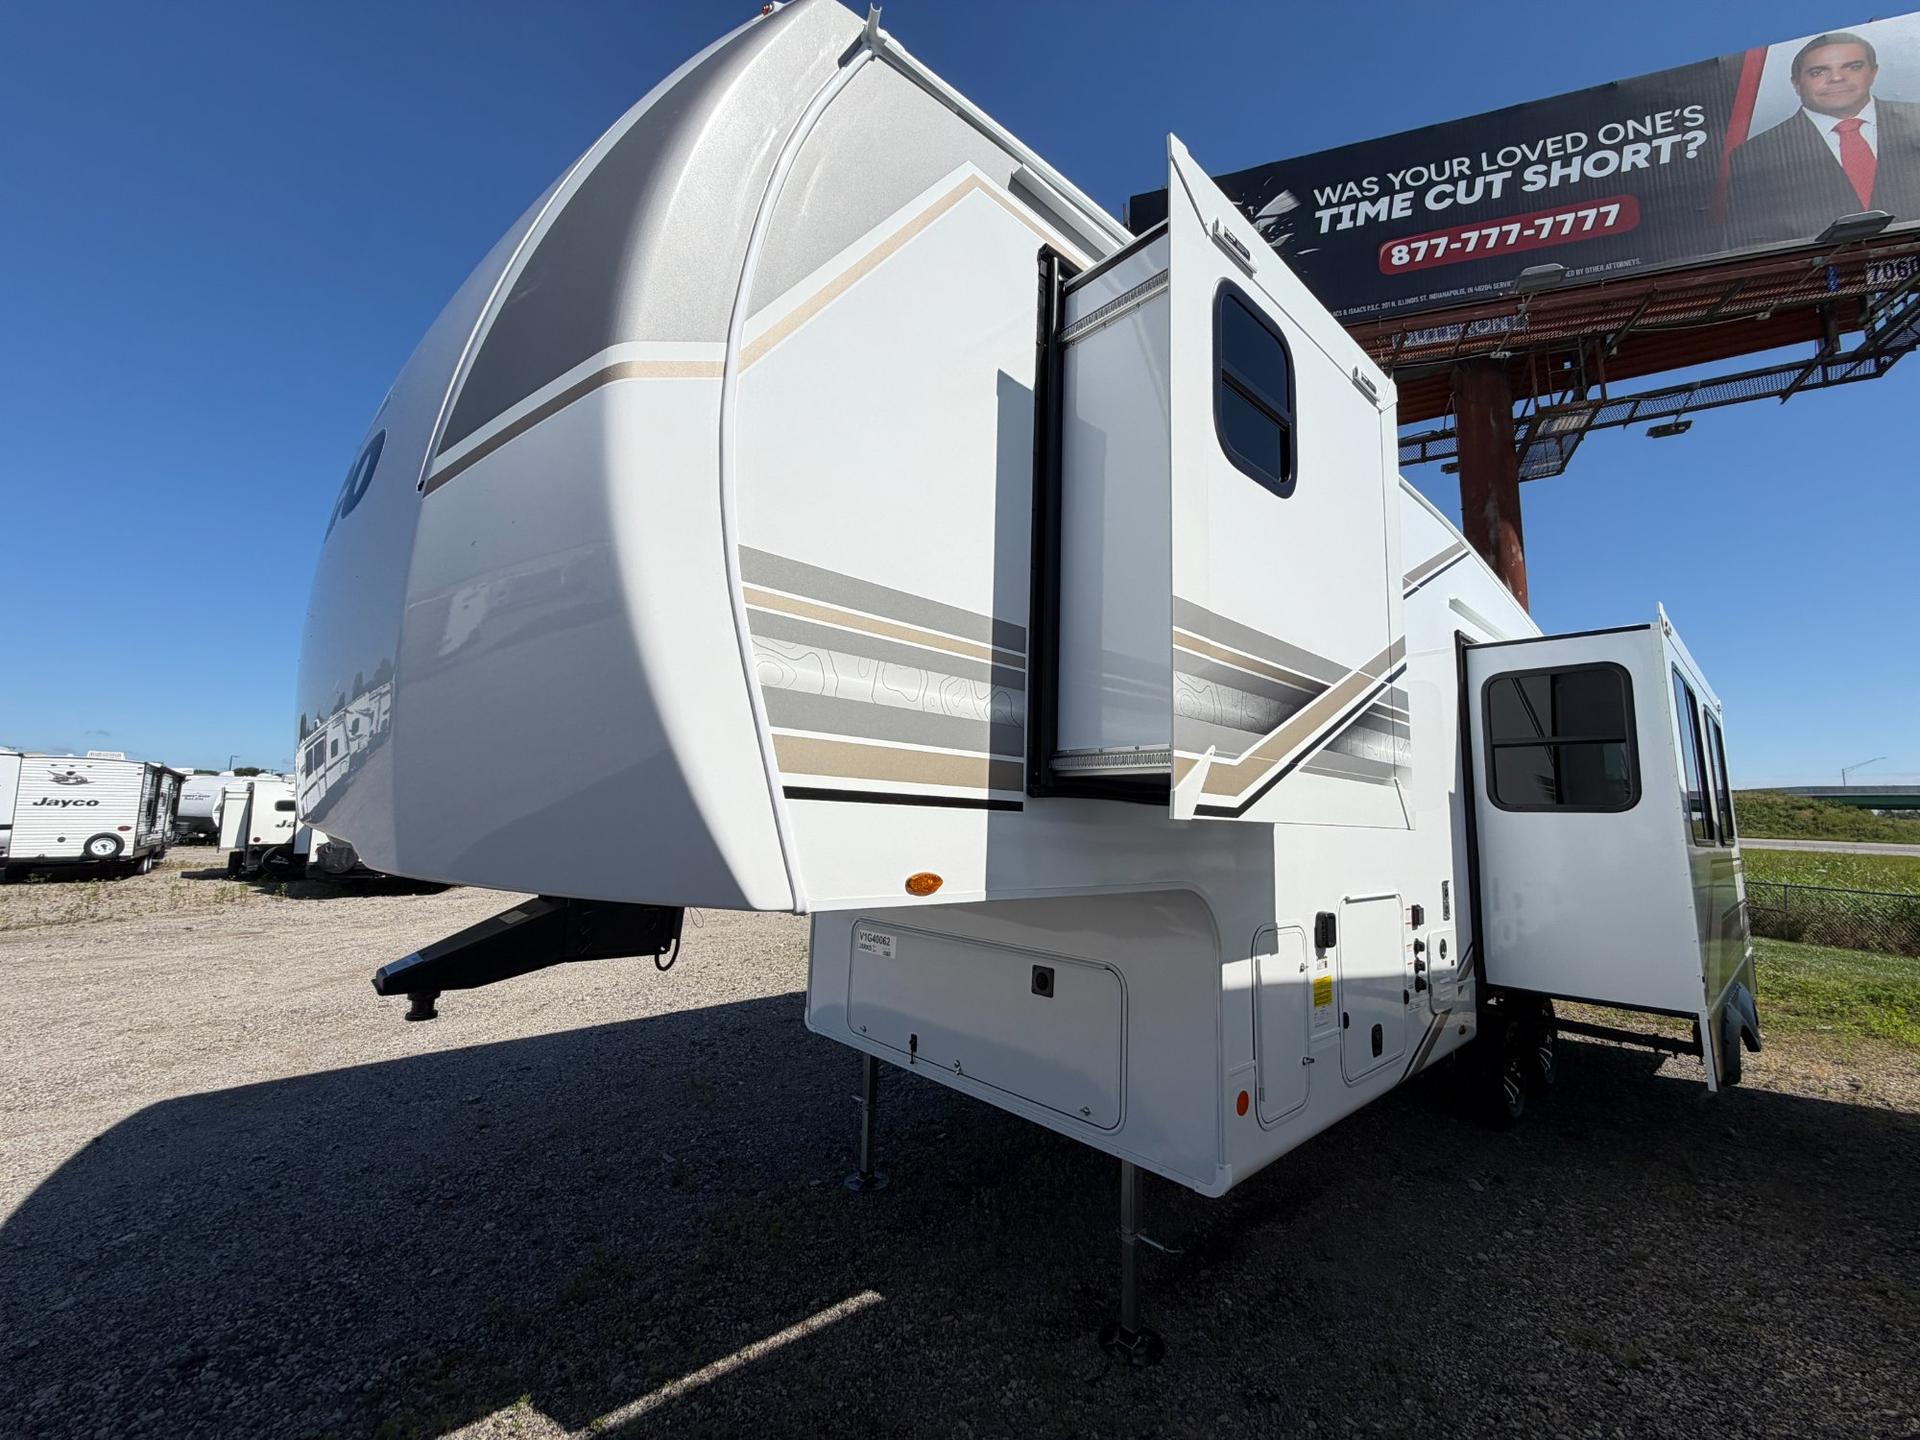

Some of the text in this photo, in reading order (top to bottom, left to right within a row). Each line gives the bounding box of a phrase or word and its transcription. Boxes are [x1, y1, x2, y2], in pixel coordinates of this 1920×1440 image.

[1314, 104, 1705, 207] WAS YOUR LOVED ONE'S
[1314, 129, 1708, 235] TIME CUT SHORT?
[1391, 203, 1620, 266] 877-777-7777
[1585, 264, 1604, 274] OTHER
[32, 797, 100, 808] Jayco
